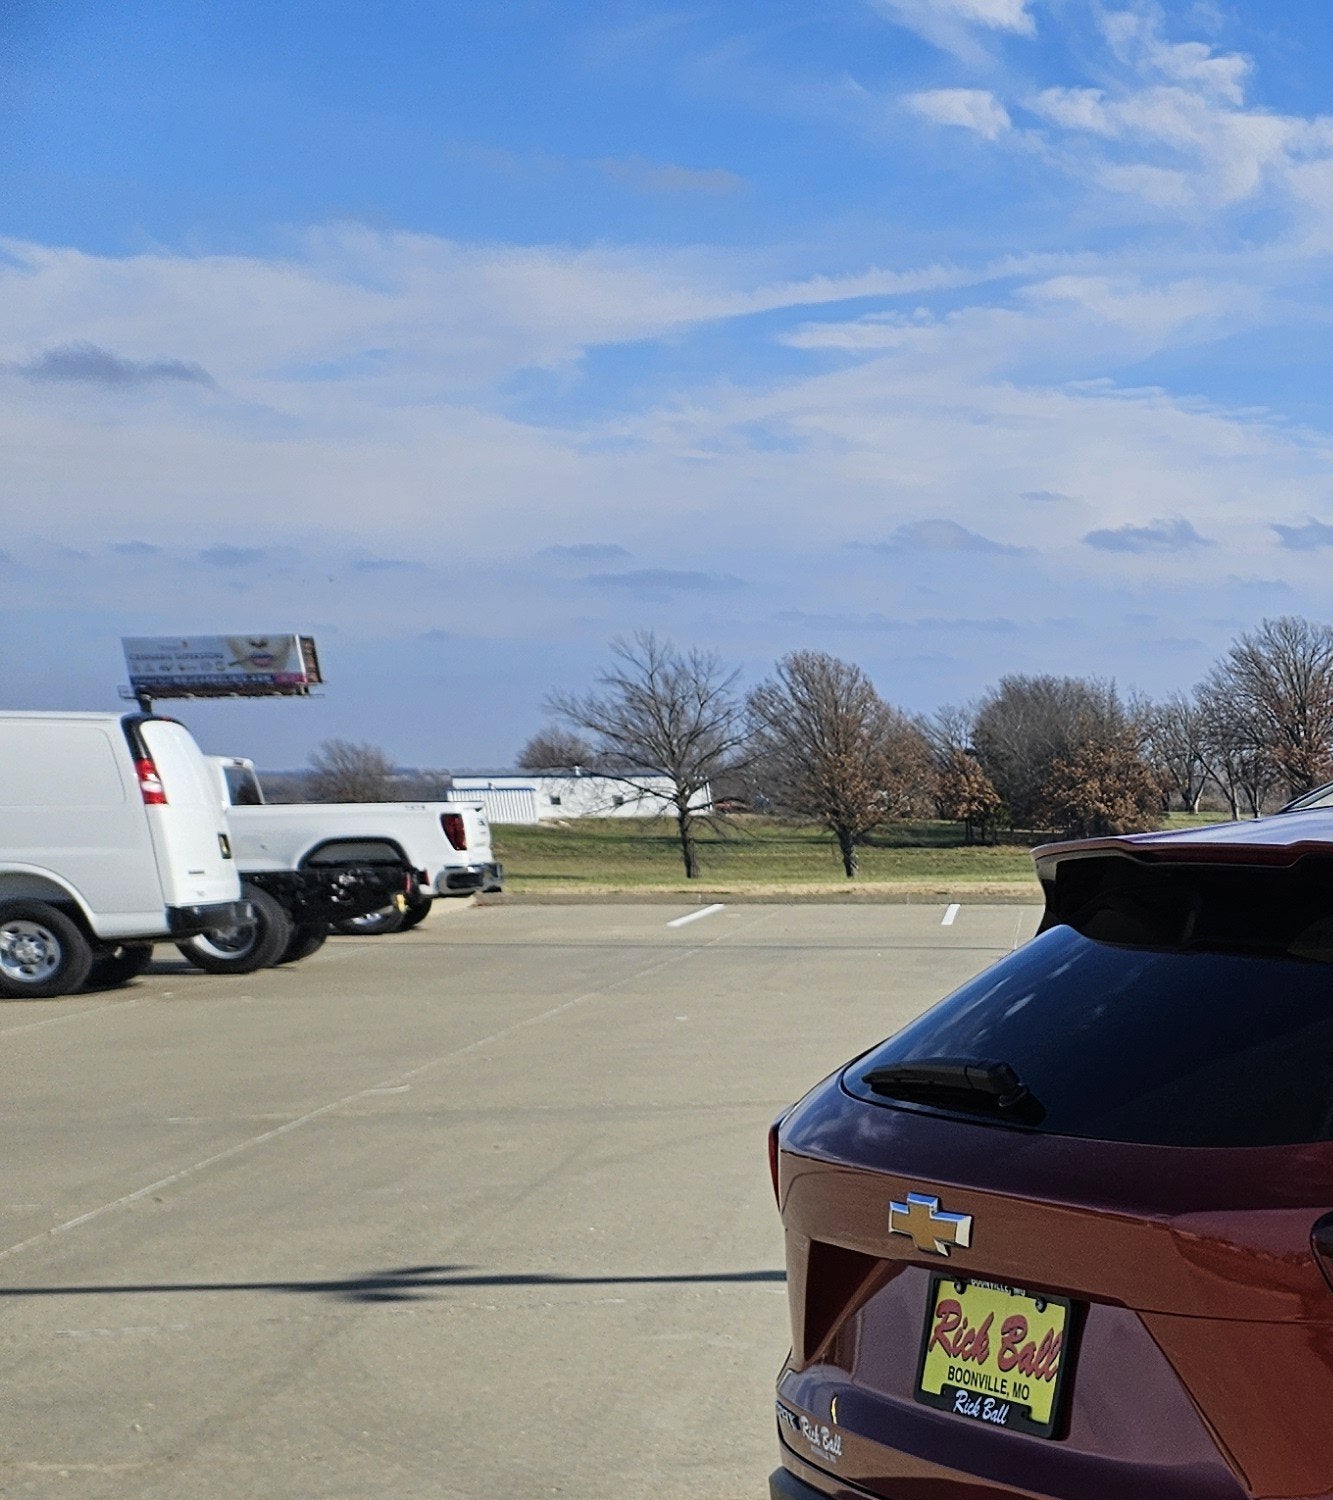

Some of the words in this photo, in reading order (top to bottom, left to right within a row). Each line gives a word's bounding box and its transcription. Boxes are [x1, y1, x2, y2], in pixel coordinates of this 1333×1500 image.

[929, 1299, 994, 1365] Rick
[997, 1314, 1063, 1382] Ball
[947, 1365, 1010, 1398] BOONVILLE,
[1013, 1381, 1030, 1401] MO
[953, 1389, 980, 1418] Rick
[982, 1397, 1010, 1425] Ball
[800, 1415, 820, 1446] Rick
[820, 1425, 842, 1456] Ball
